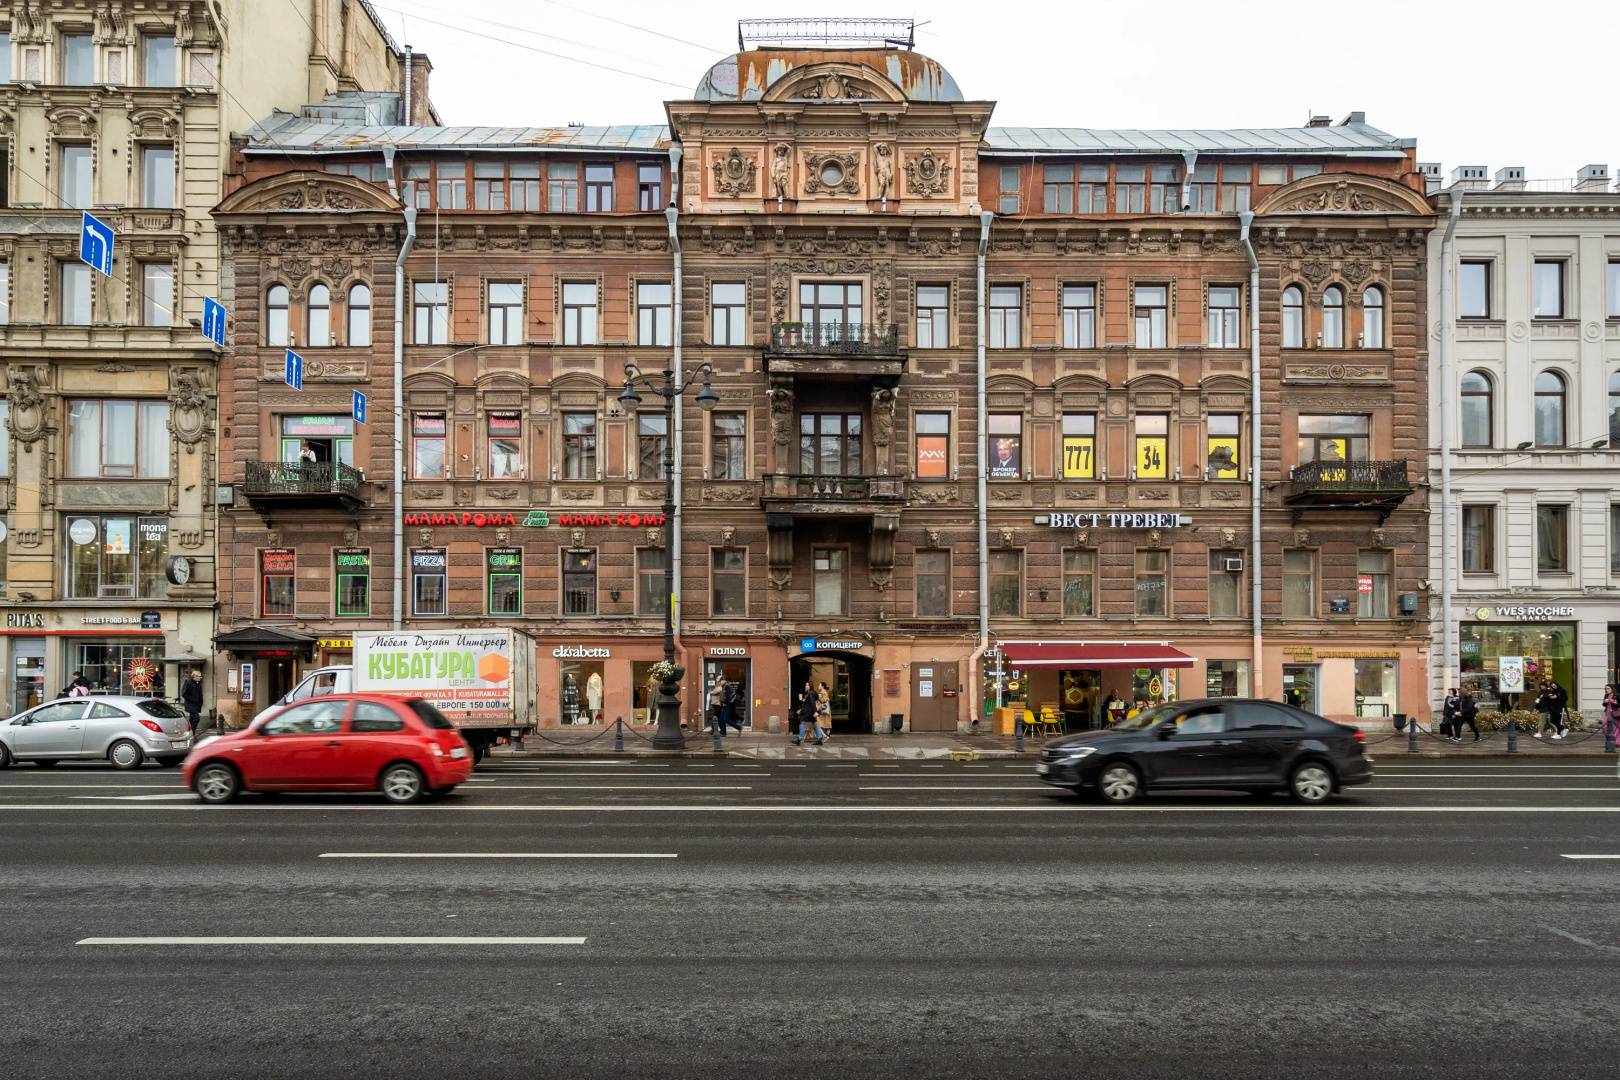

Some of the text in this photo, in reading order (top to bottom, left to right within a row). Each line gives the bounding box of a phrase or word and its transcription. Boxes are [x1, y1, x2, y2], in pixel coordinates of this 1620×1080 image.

[1065, 446, 1091, 470] 777
[1144, 446, 1160, 470] 34
[462, 513, 516, 526] РОМА
[1049, 513, 1181, 528] ВЕСТ ТРЕВЕЛ
[338, 555, 368, 566] PASTA
[414, 555, 445, 566] PIZZA
[489, 555, 521, 566] GRILL
[1497, 607, 1574, 615] YVES ROCHER
[7, 614, 44, 627] PITA'S
[370, 635, 506, 650] Мебель Дизайн Интерьер
[369, 652, 475, 679] КУБАТУРА
